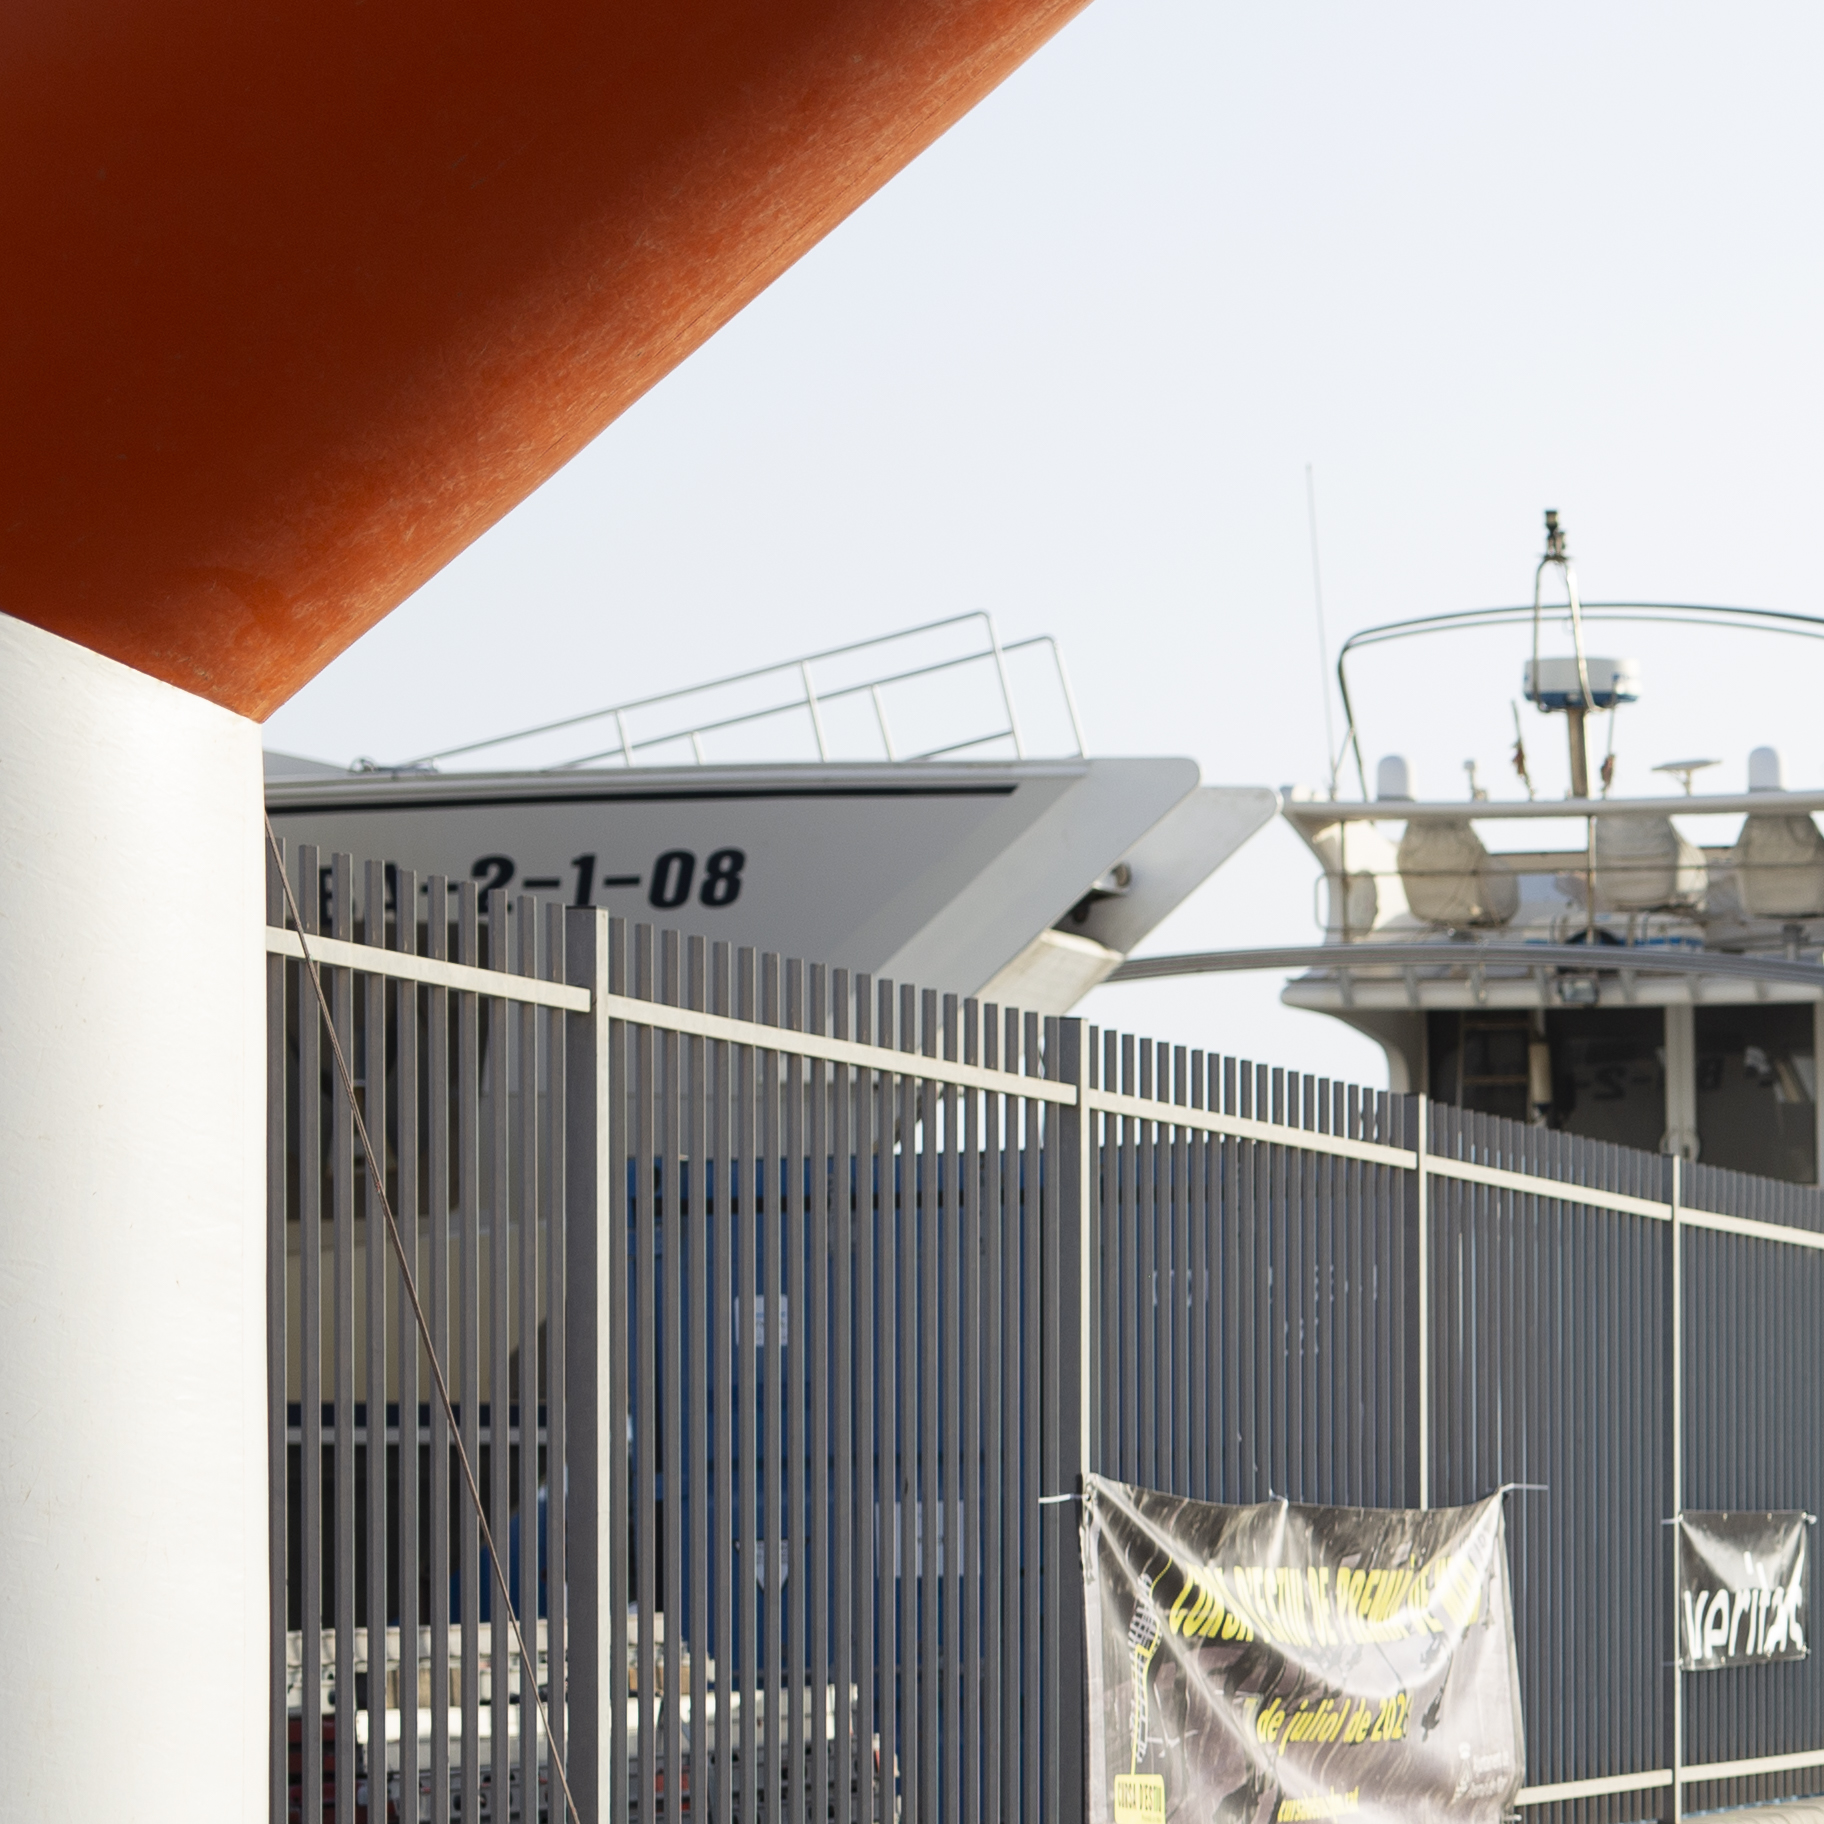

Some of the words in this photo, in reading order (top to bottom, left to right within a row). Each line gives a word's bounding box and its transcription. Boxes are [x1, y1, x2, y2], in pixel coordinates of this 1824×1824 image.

[1257, 1697, 1286, 1744] de
[1278, 1698, 1351, 1756] juliol
[1343, 1697, 1372, 1744] de
